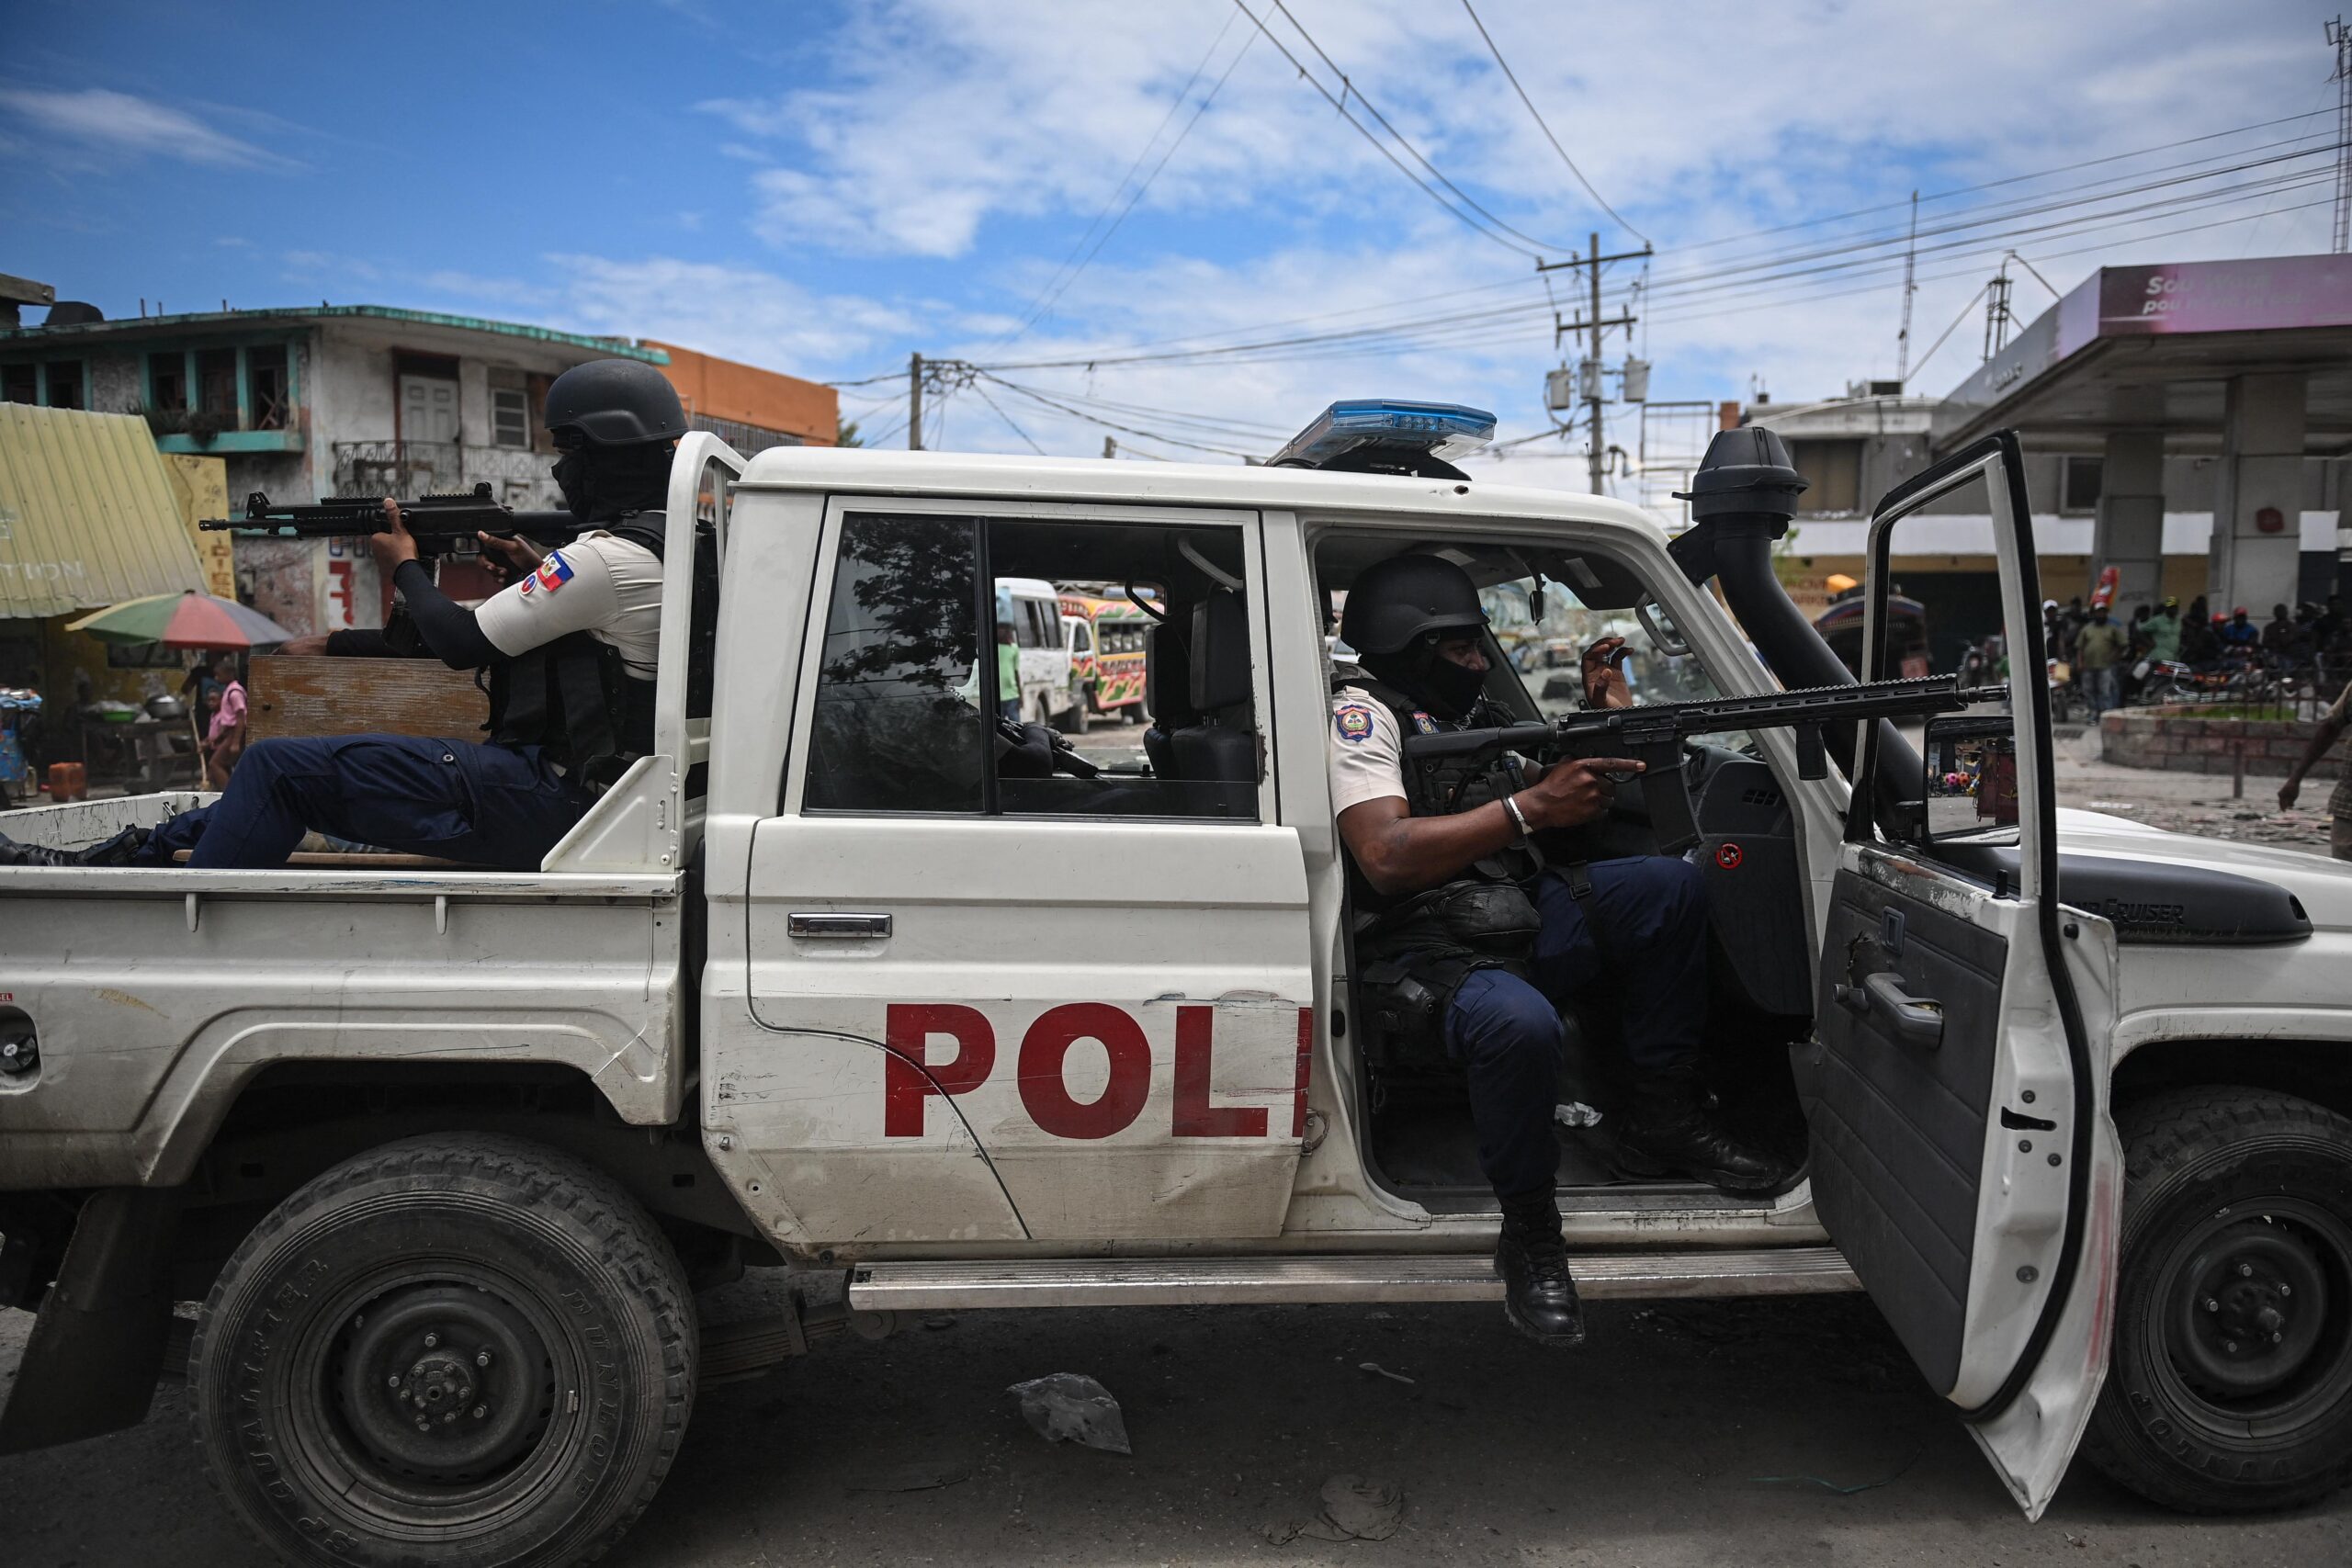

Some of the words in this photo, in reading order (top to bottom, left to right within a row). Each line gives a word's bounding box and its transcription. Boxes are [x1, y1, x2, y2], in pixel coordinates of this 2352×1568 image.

[2144, 276, 2194, 295] Sou
[2143, 298, 2180, 315] pou
[560, 1288, 619, 1500] DUNLOP
